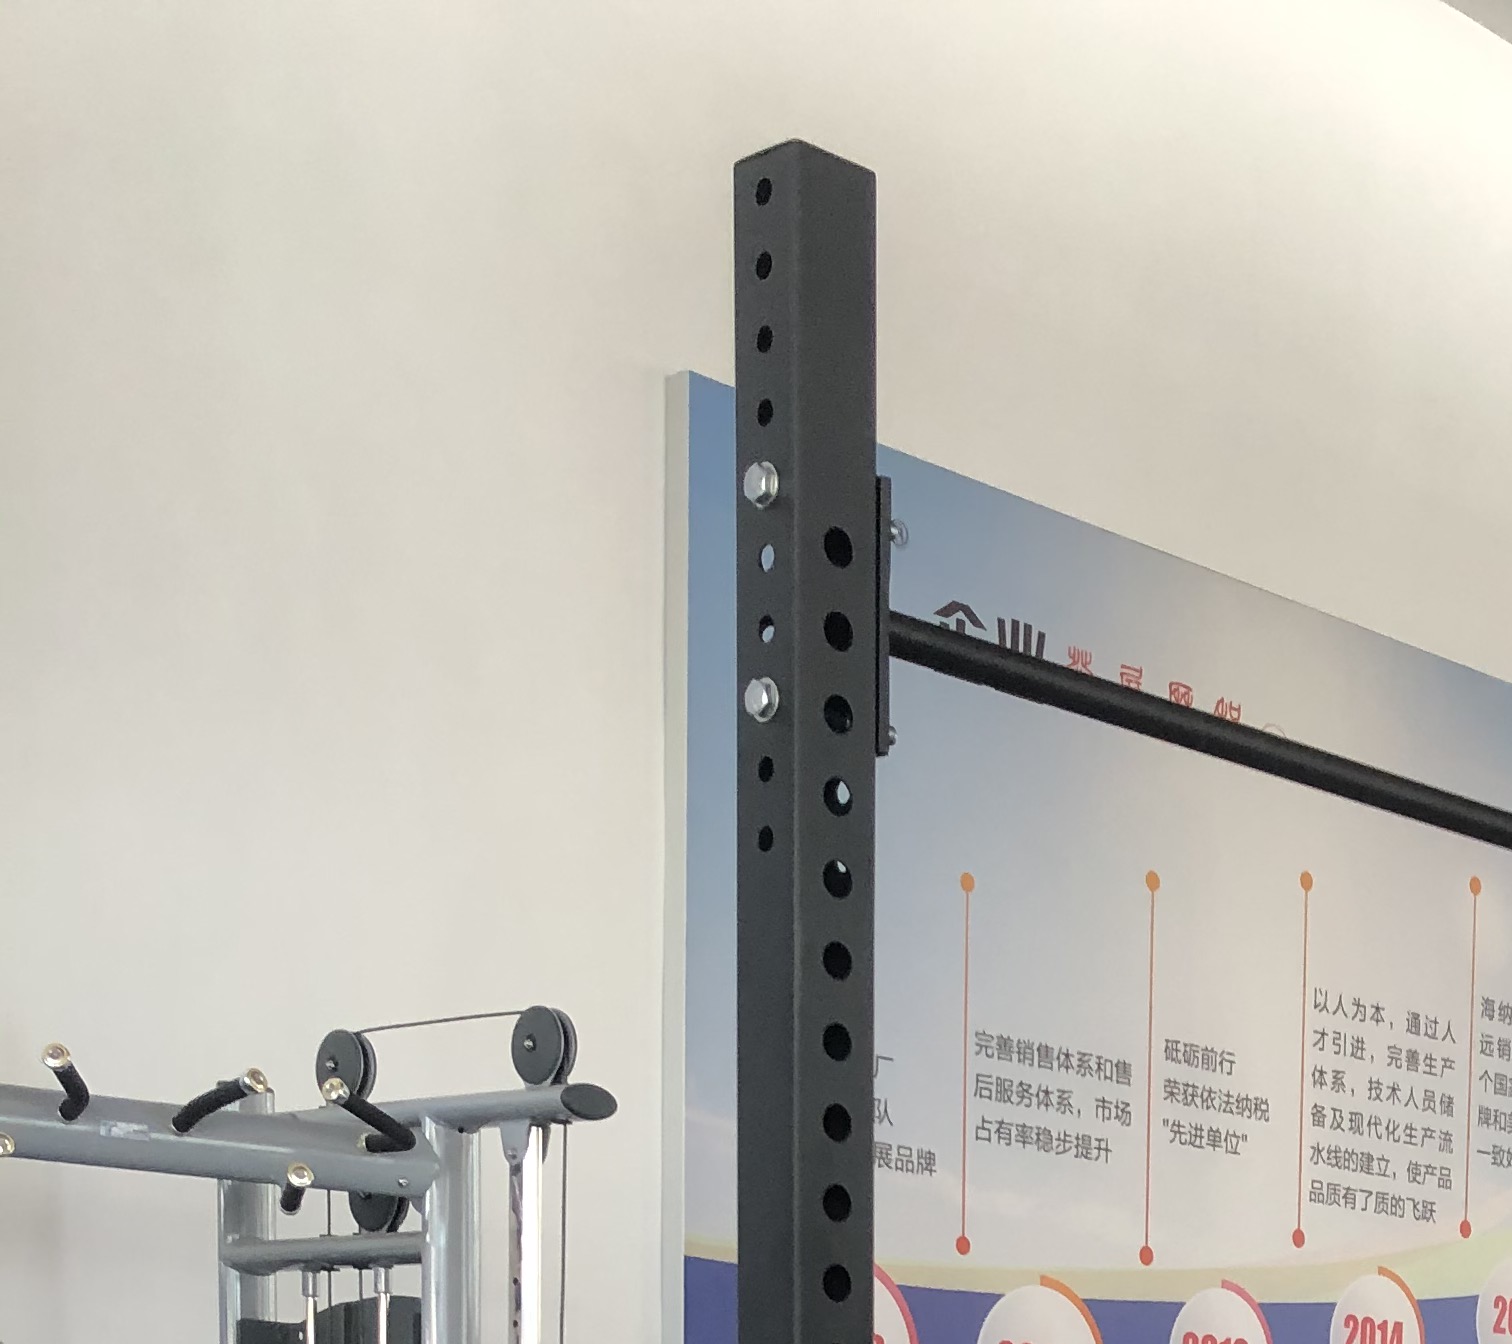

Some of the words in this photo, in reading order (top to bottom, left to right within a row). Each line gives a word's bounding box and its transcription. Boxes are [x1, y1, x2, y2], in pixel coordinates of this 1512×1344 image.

[1313, 987, 1456, 1044] 以人为本，通过人
[974, 1030, 1133, 1088] 完善销售体系和售
[1164, 1039, 1237, 1077] 砥砺前行
[1312, 1028, 1456, 1079] 才引进，完善生产
[973, 1073, 1132, 1127] 后服务体系，市场
[1163, 1078, 1271, 1124] 荣获依法纳税
[1311, 1064, 1455, 1119] 体系，技术人员储
[974, 1116, 1113, 1165] 占有率稳步提升
[1310, 1103, 1454, 1155] 备及现代化生产流
[874, 1141, 937, 1177] 展品牌
[1309, 1142, 1453, 1191] 水线的建立，使产品
[1308, 1179, 1436, 1224] 品质有了质的飞跃
